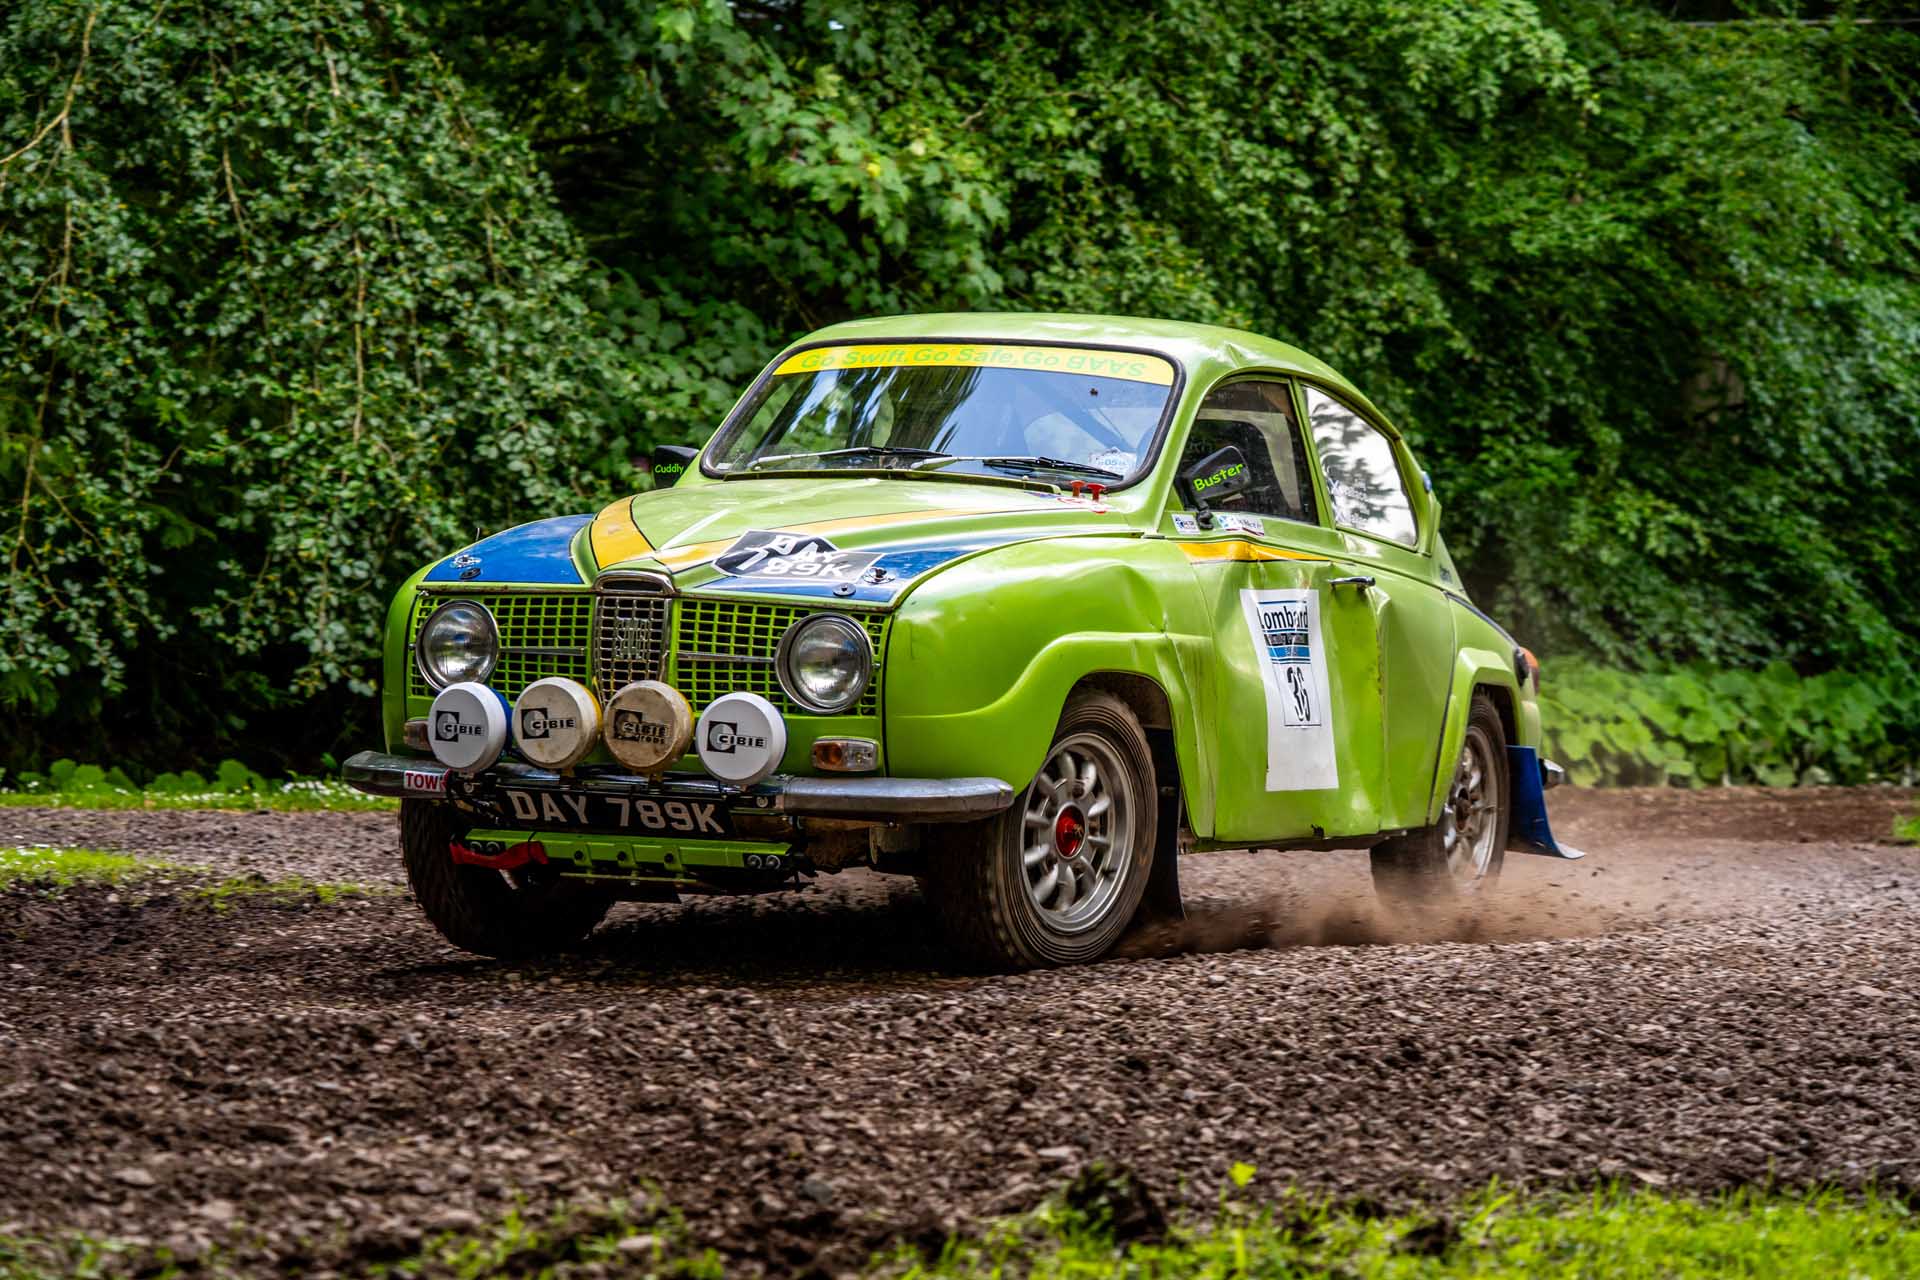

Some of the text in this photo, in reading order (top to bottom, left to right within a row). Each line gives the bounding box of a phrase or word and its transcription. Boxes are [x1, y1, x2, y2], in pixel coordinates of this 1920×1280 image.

[801, 353, 835, 368] Go
[913, 348, 949, 362] Go
[1023, 351, 1060, 366] Go
[654, 463, 685, 475] Cuddly
[1193, 463, 1244, 491] Buster
[734, 547, 853, 578] 789K
[1256, 605, 1309, 629] Lombard
[445, 724, 482, 735] CIBIE
[532, 719, 575, 730] CIBIE
[719, 735, 764, 748] CIBIE
[405, 772, 438, 790] TOW
[506, 790, 725, 834] DAY 789K
